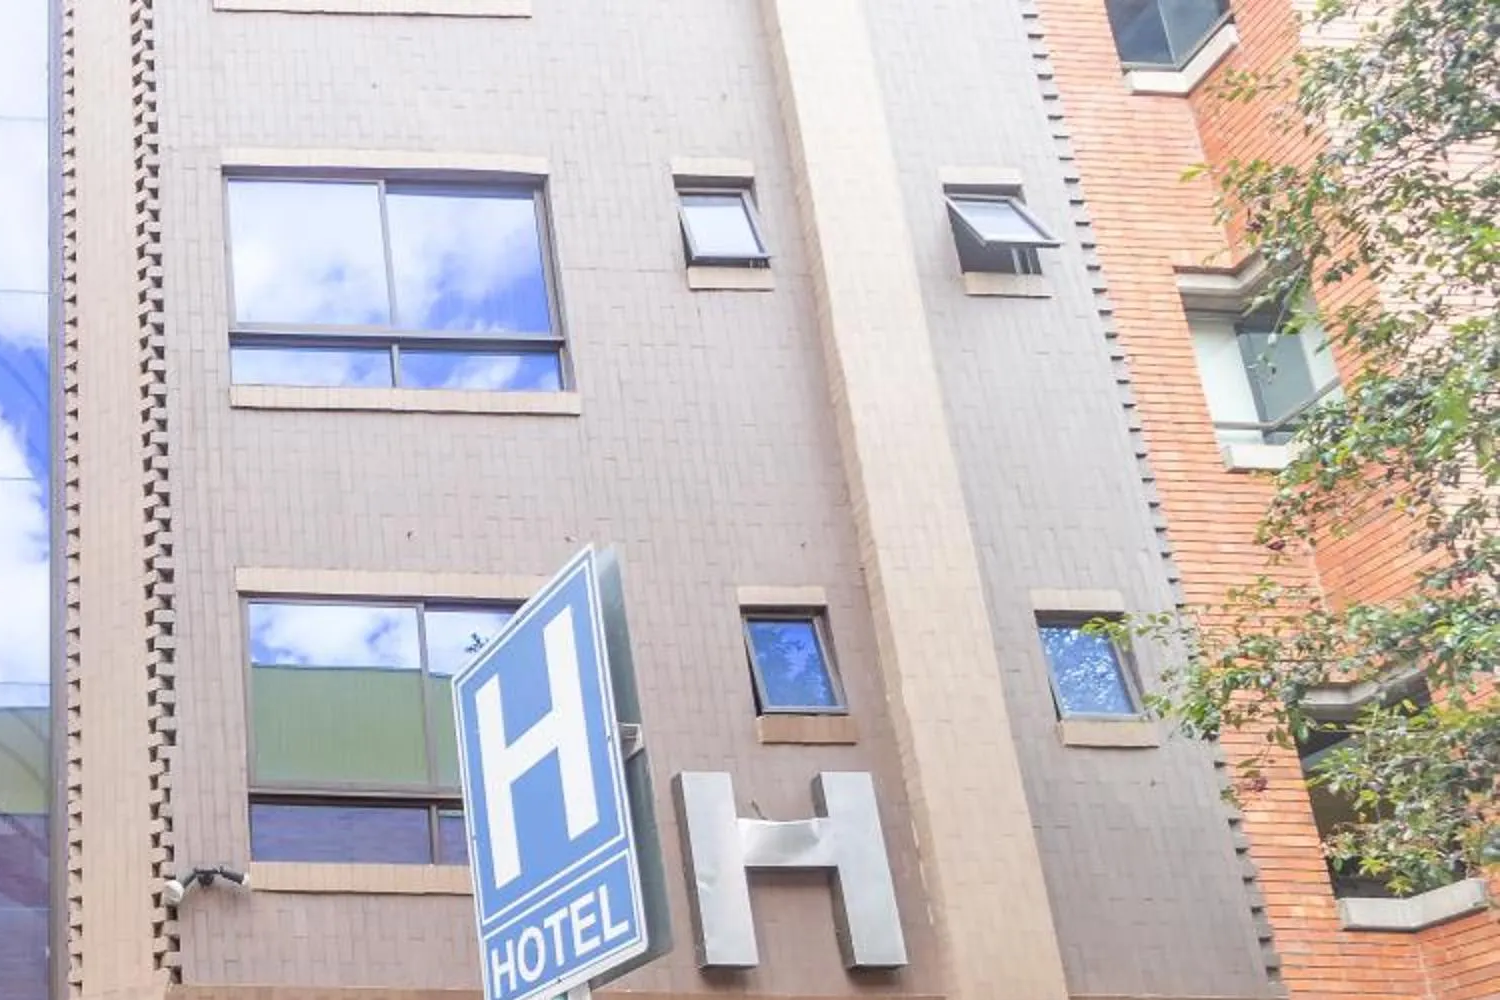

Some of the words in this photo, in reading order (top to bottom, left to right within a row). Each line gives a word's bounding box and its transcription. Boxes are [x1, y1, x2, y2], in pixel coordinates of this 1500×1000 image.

[475, 604, 599, 889] H
[491, 884, 629, 999] HOTEL
[672, 771, 908, 968] H
